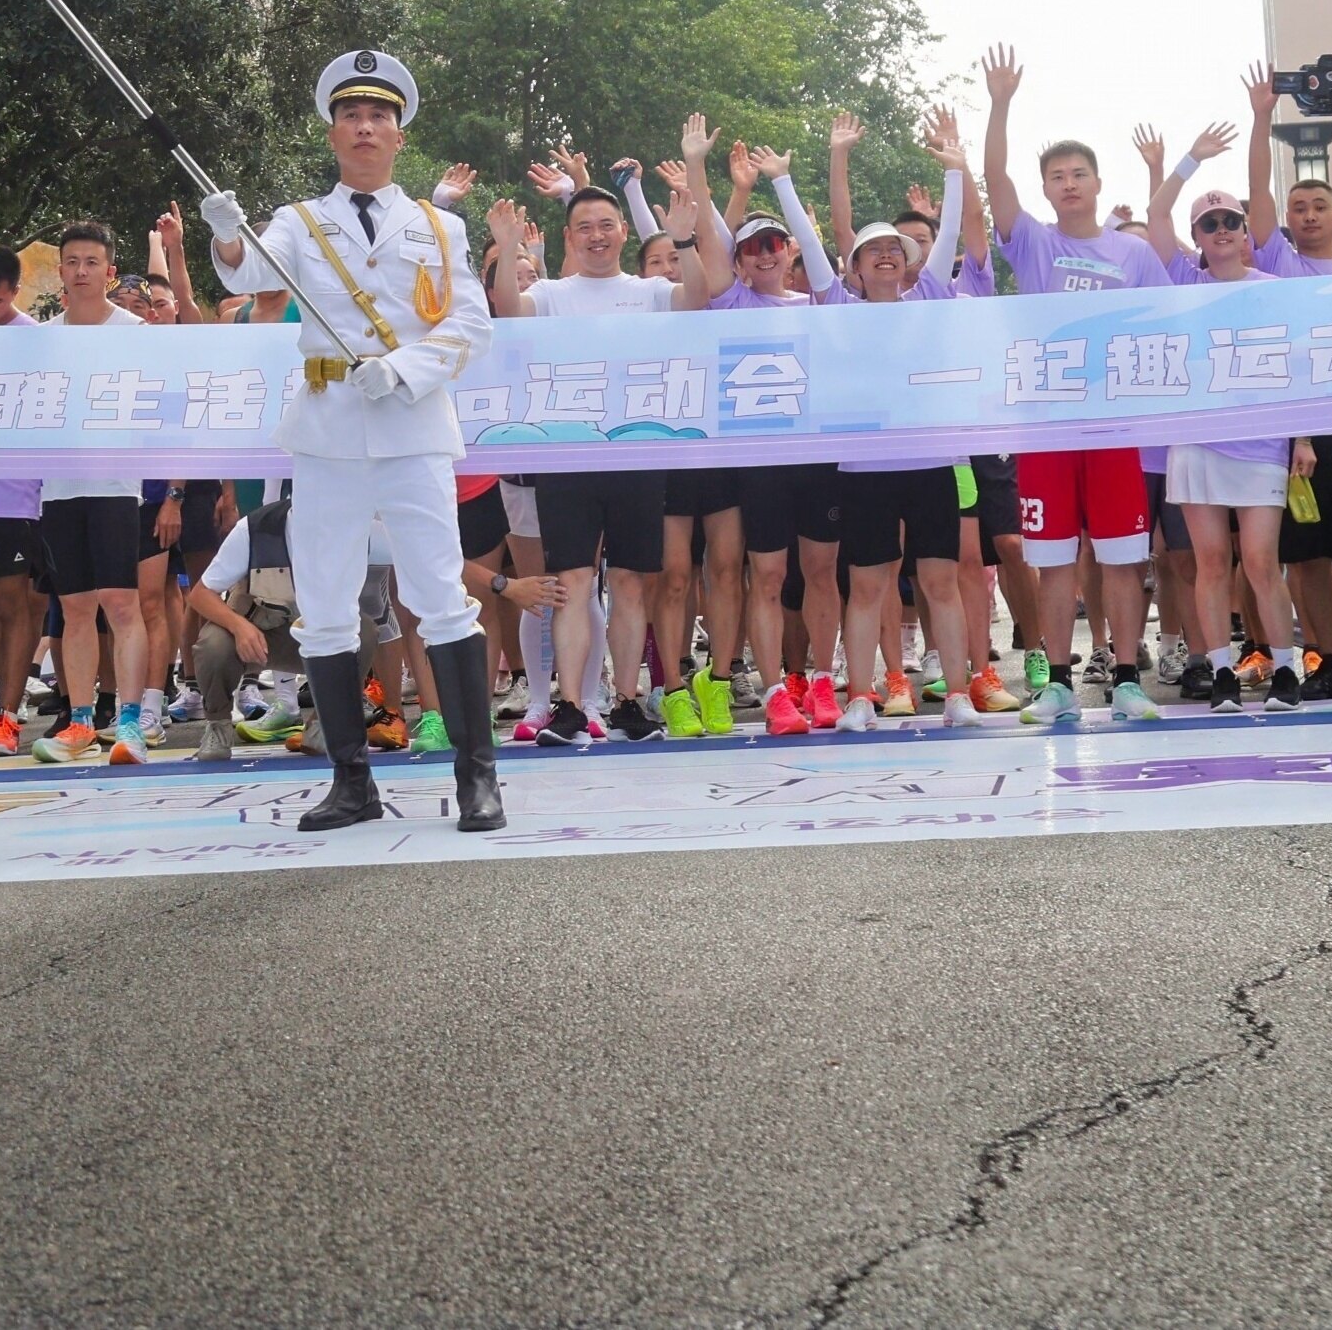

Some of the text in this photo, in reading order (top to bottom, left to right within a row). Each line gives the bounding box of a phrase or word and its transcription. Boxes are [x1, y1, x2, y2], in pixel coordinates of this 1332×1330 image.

[1207, 193, 1222, 206] LA
[782, 806, 1125, 833] 运动会
[7, 840, 328, 863] A-LIVING
